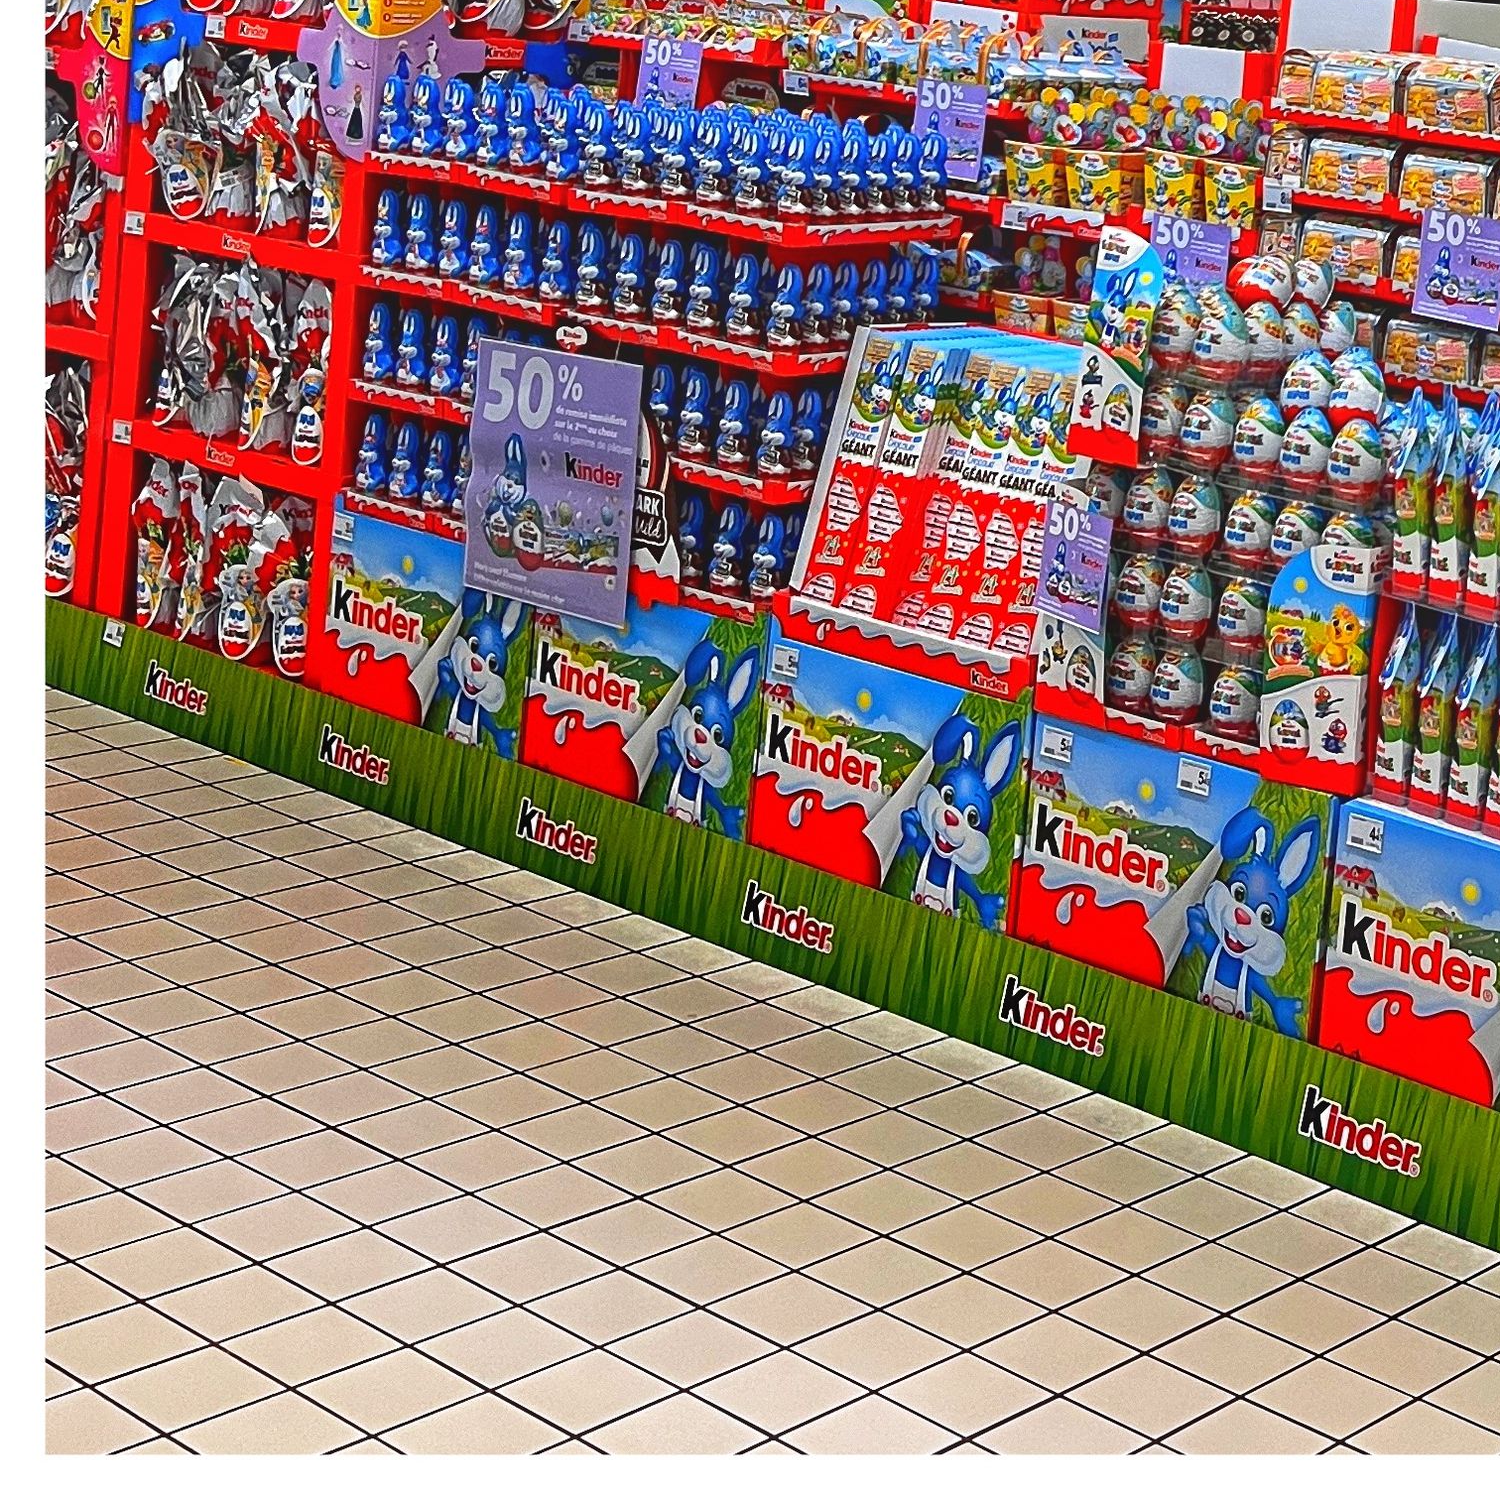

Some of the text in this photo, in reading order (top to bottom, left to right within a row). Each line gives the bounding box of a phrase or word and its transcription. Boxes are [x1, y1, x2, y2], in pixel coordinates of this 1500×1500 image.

[238, 23, 268, 38] Kinder
[485, 45, 524, 60] Kinder
[645, 40, 682, 66] 50%
[921, 80, 964, 110] 50%
[222, 234, 251, 253] Kinder
[1156, 217, 1204, 249] 50%
[1426, 211, 1481, 246] 50%
[1470, 254, 1500, 271] Kinder
[483, 350, 583, 430] 50%
[842, 439, 876, 458] GÉANT
[890, 429, 913, 442] Kinder
[205, 447, 235, 466] Kinder
[882, 450, 919, 468] GÉANT
[970, 445, 992, 460] Kinder
[1006, 453, 1029, 467] Kinder
[564, 452, 622, 489] Kinder
[962, 466, 999, 485] GÉANT
[1000, 474, 1036, 493] GÉANT
[636, 494, 660, 517] ARK
[1049, 504, 1091, 541] 50%
[333, 580, 422, 644] Kinder
[145, 662, 207, 713] Kinder
[539, 640, 638, 713] Kinder
[969, 668, 1008, 693] Kinder
[320, 725, 389, 784] Kinder
[768, 714, 880, 792] Kinder
[518, 798, 597, 863] Kinder
[1035, 803, 1166, 892] Kinder
[742, 882, 832, 952] Kinder
[1343, 901, 1493, 1002] Kinder
[1000, 975, 1104, 1054] Kinder
[1301, 1086, 1421, 1175] Kinder
